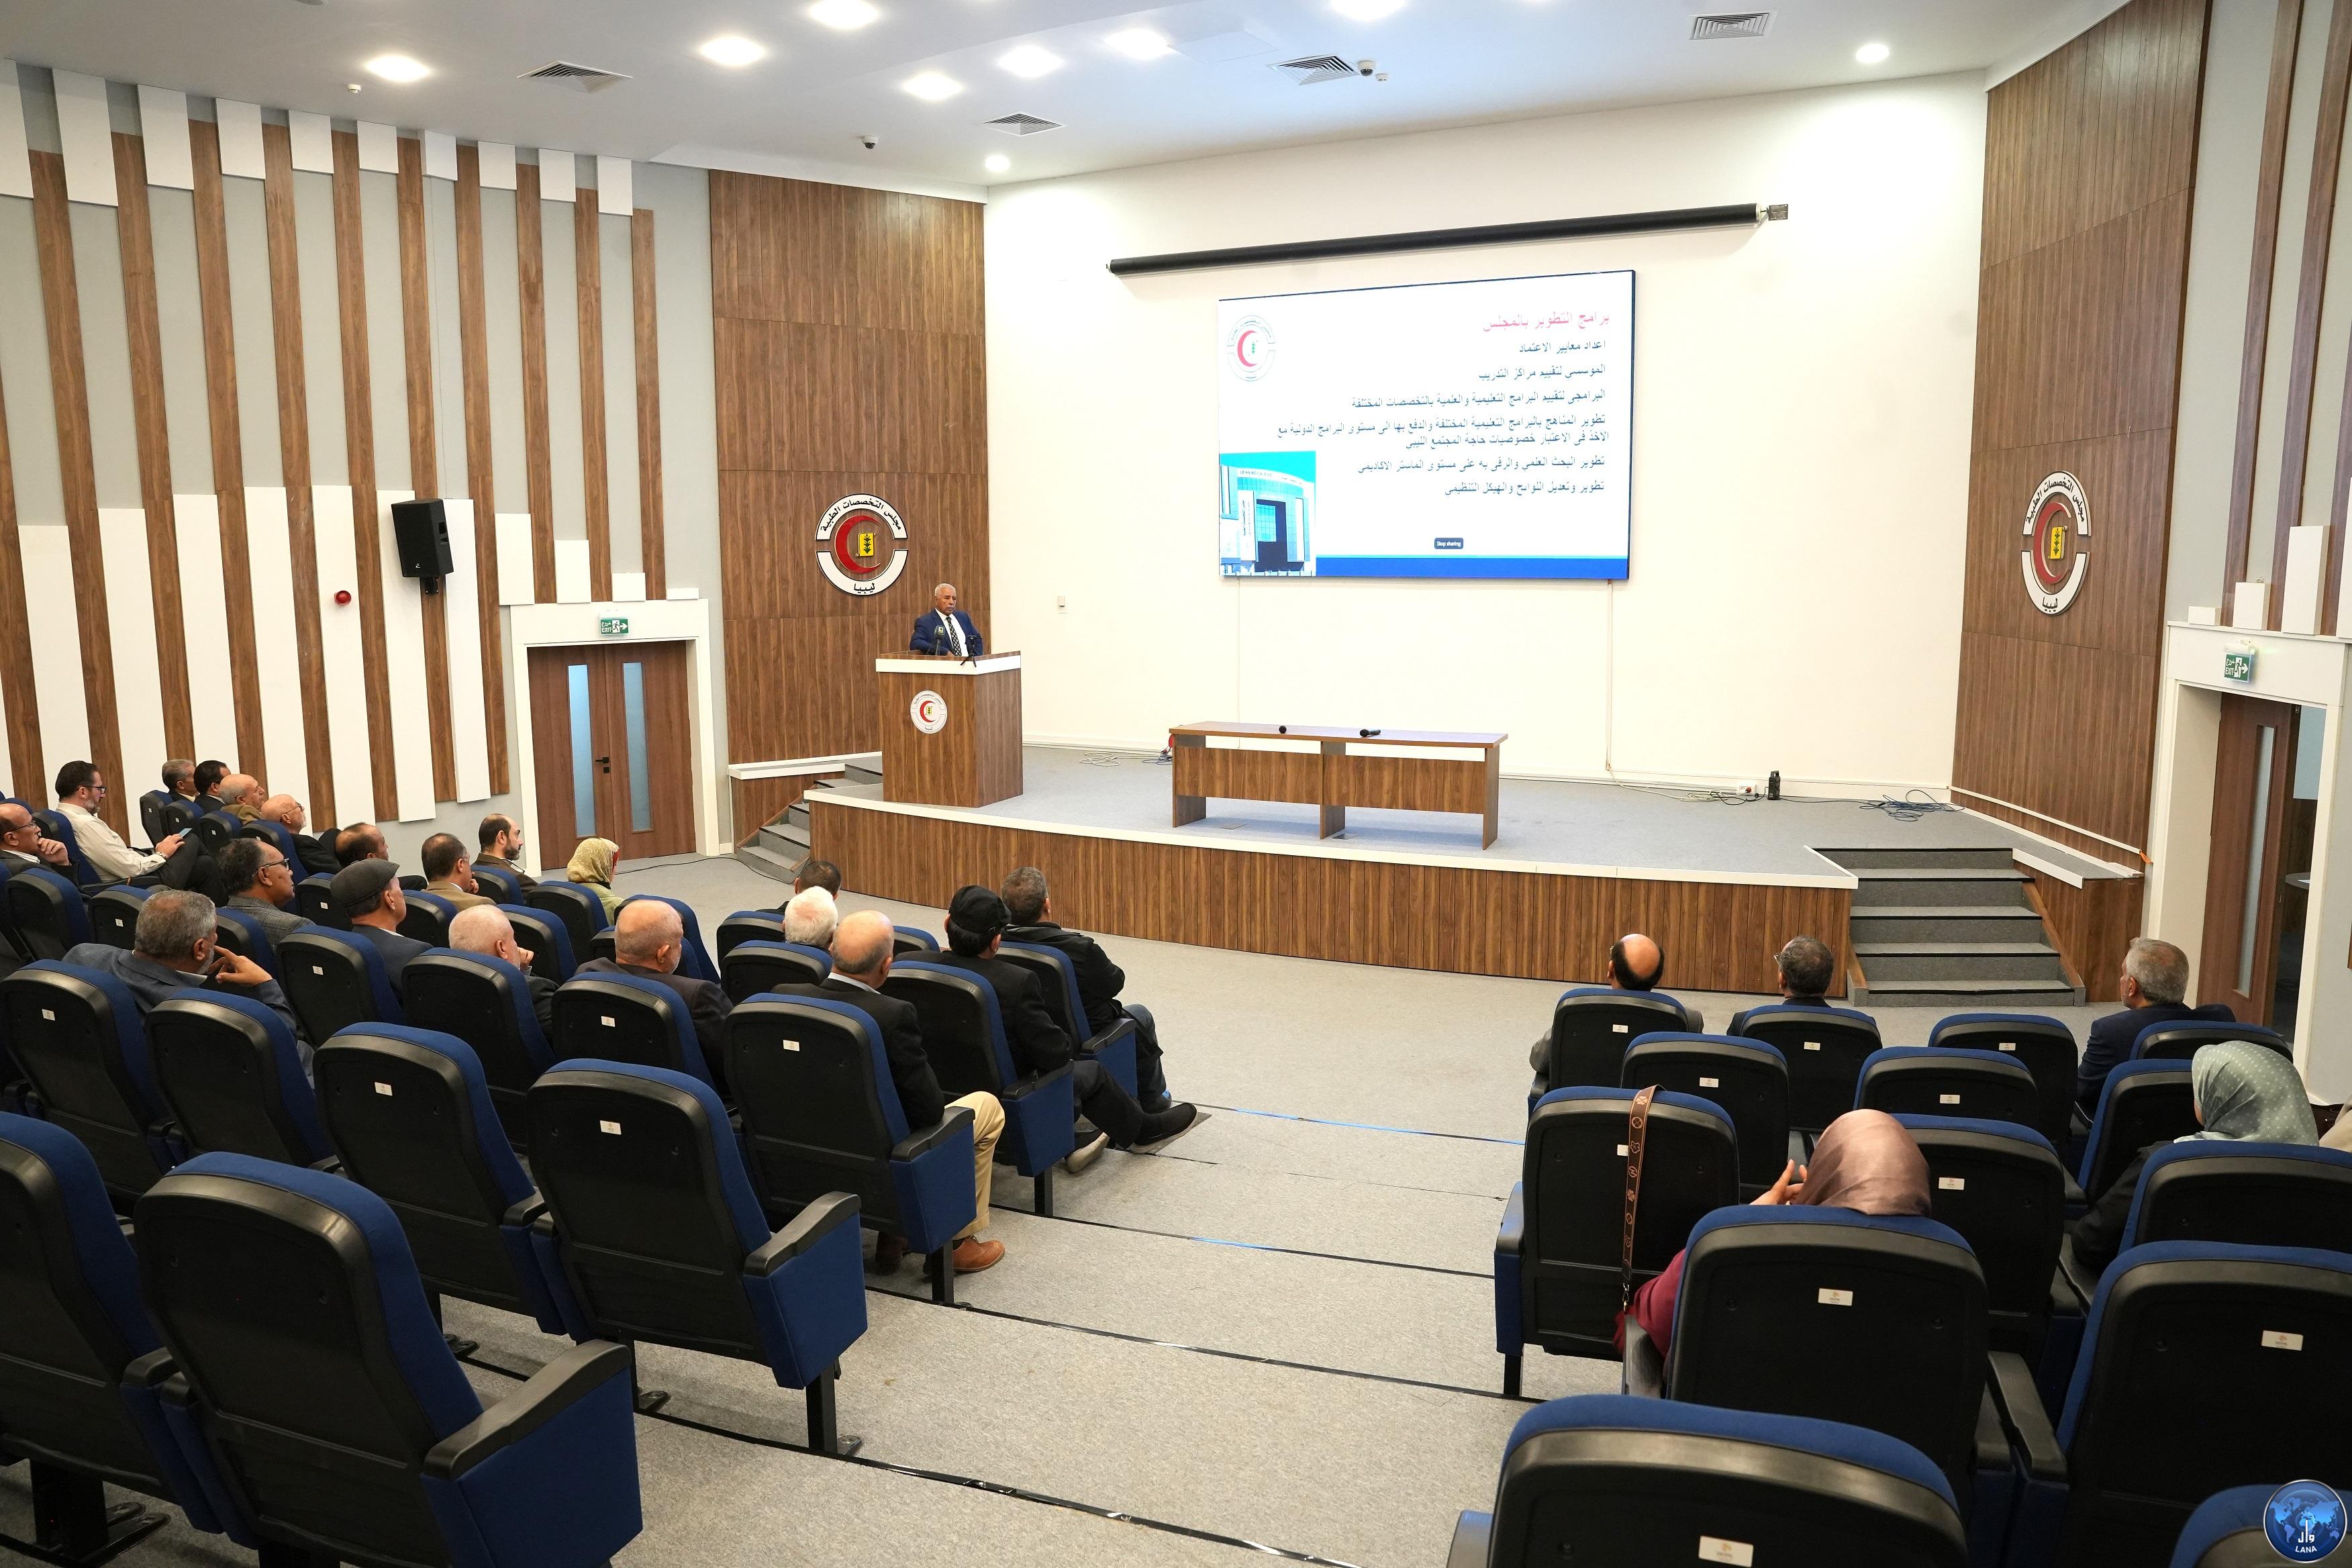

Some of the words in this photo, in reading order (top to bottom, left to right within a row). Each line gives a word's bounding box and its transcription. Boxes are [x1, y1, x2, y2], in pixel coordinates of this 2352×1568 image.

[1483, 315, 1528, 332] بالمجلس
[1535, 311, 1572, 329] التطوير
[1578, 311, 1610, 330] برامج
[1519, 342, 1551, 352] الاعتماد
[1556, 342, 1581, 354] معايير
[1479, 368, 1509, 381] التدريب
[1514, 368, 1536, 381] مراكز
[1539, 365, 1562, 379] لتقييم
[1352, 397, 1383, 408] المختلفة
[1385, 395, 1434, 407] بالتخصصات
[1436, 395, 1469, 407] والعلمية
[1471, 391, 1505, 405] التعليمية
[1509, 393, 1538, 407] البرامج
[1542, 390, 1565, 403] لتقييم
[1408, 419, 1433, 434] والدفع
[1435, 418, 1468, 430] المختلفة
[1471, 416, 1506, 430] التعليمية
[1509, 416, 1542, 432] بالبرامج
[1546, 415, 1576, 430] المناهج
[1580, 413, 1606, 428] تطوير
[1277, 428, 1287, 438] مع
[1290, 423, 1314, 436] الدولية
[1318, 423, 1344, 438] البرامج
[1393, 422, 1406, 434] بها
[1430, 436, 1461, 450] المجتمع
[1465, 435, 1486, 444] حاجة
[1489, 433, 1536, 446] خصوصيات
[1540, 433, 1571, 445] الاعتبار
[1397, 460, 1424, 473] الماستر
[1479, 459, 1488, 471] به
[1551, 456, 1575, 467] البحث
[1580, 457, 1605, 469] تطوير
[1482, 482, 1514, 495] والهيكل
[1547, 481, 1576, 494] وتعديل
[1580, 480, 1604, 493] تطوير
[2043, 477, 2074, 493] التخصصات
[842, 497, 885, 510] التخصصات
[2024, 489, 2042, 524] الطبية
[2072, 493, 2086, 523] مجلس
[820, 505, 842, 532] الطبية
[883, 509, 901, 530] مجلس
[853, 583, 875, 595] ليبيا
[2042, 596, 2058, 613] ليبيا
[2226, 658, 2235, 667] خروج
[2225, 667, 2235, 675] EXIT
